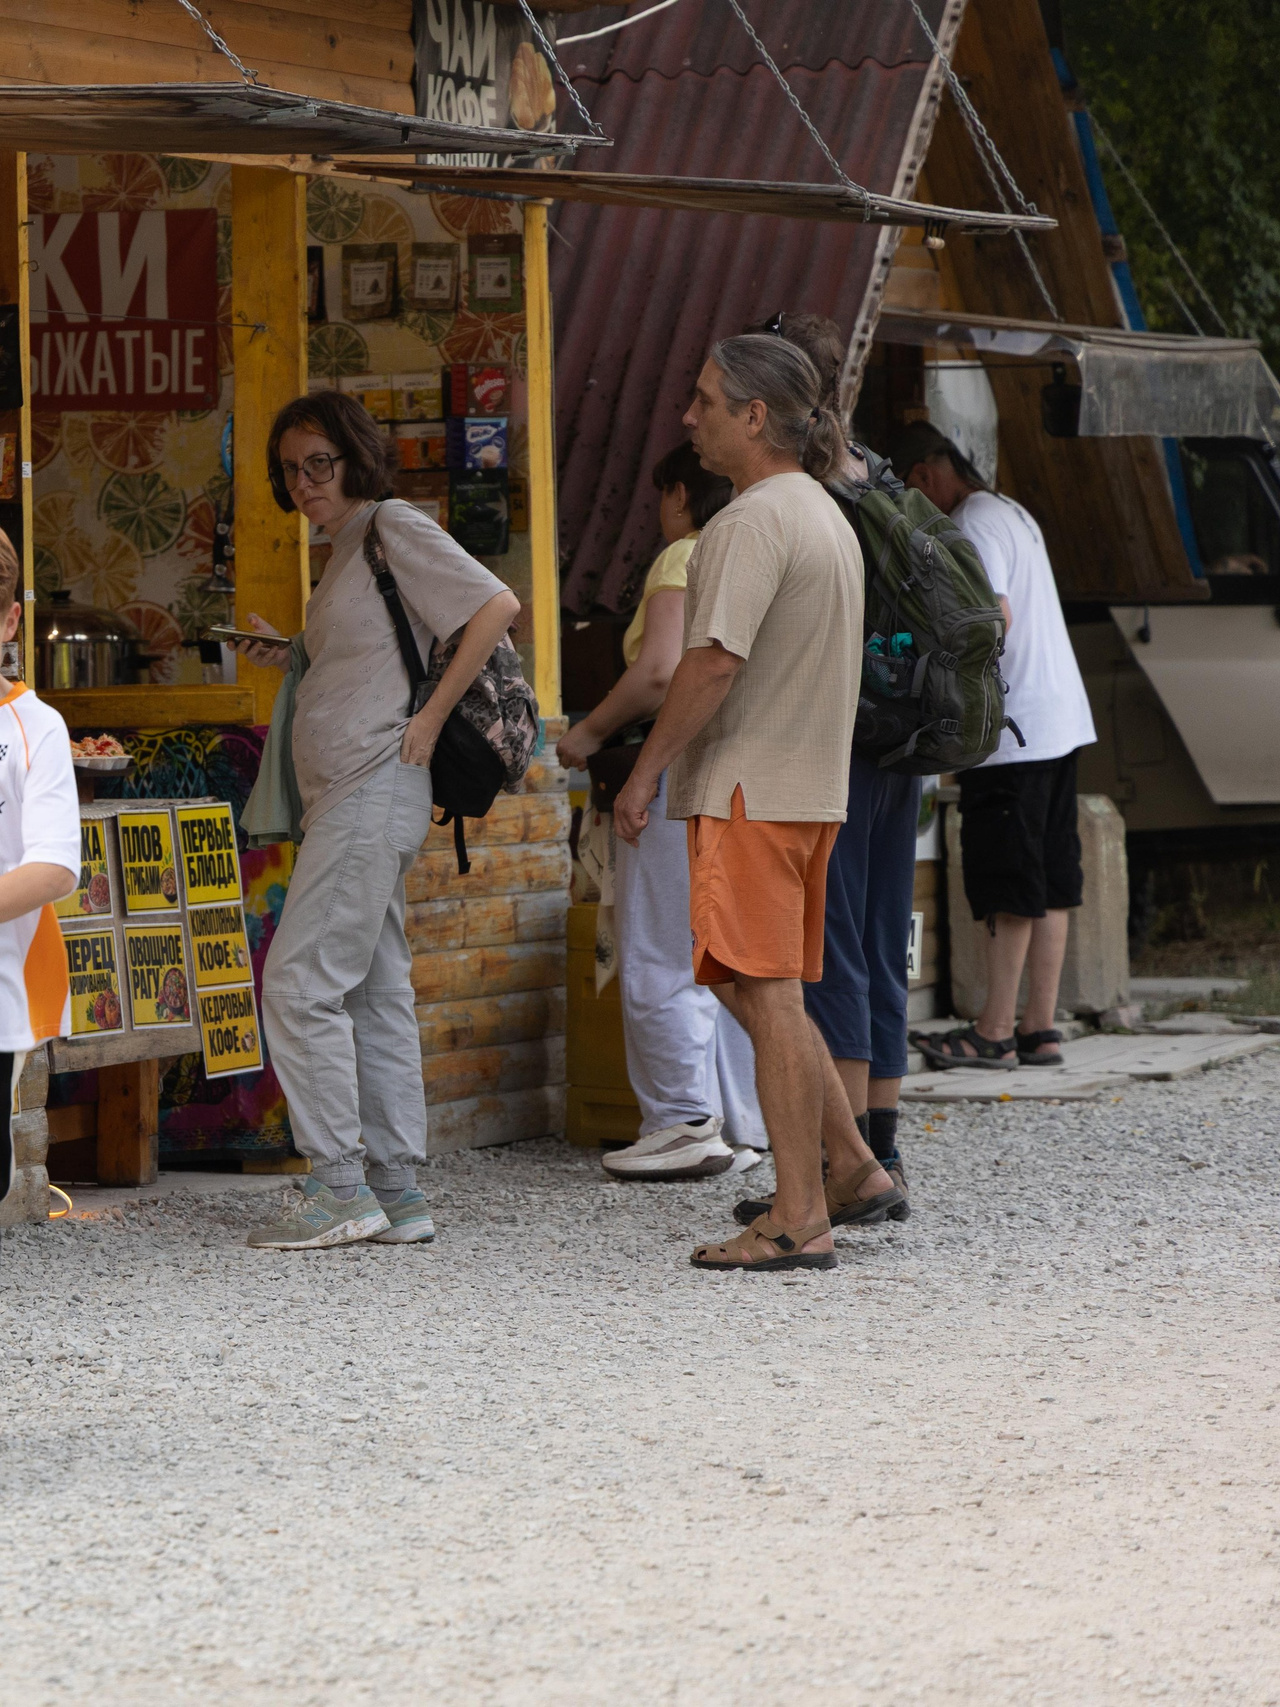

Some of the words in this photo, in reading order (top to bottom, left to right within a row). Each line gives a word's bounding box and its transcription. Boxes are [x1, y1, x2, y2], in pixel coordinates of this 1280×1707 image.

[426, 74, 497, 127] КОФЕ
[121, 825, 163, 864] ПЛОВ
[180, 817, 234, 854] ПЕРВЫЕ
[131, 866, 162, 896] ГРИБАМИ
[186, 852, 237, 890] БЛЮДА
[128, 934, 183, 968] ОВОЩНОЕ
[197, 940, 232, 972] КОФЕ
[131, 967, 160, 1000] РАГУ
[199, 987, 254, 1025] КЕДРОВЫЙ
[208, 1026, 241, 1058] КОФЕ
